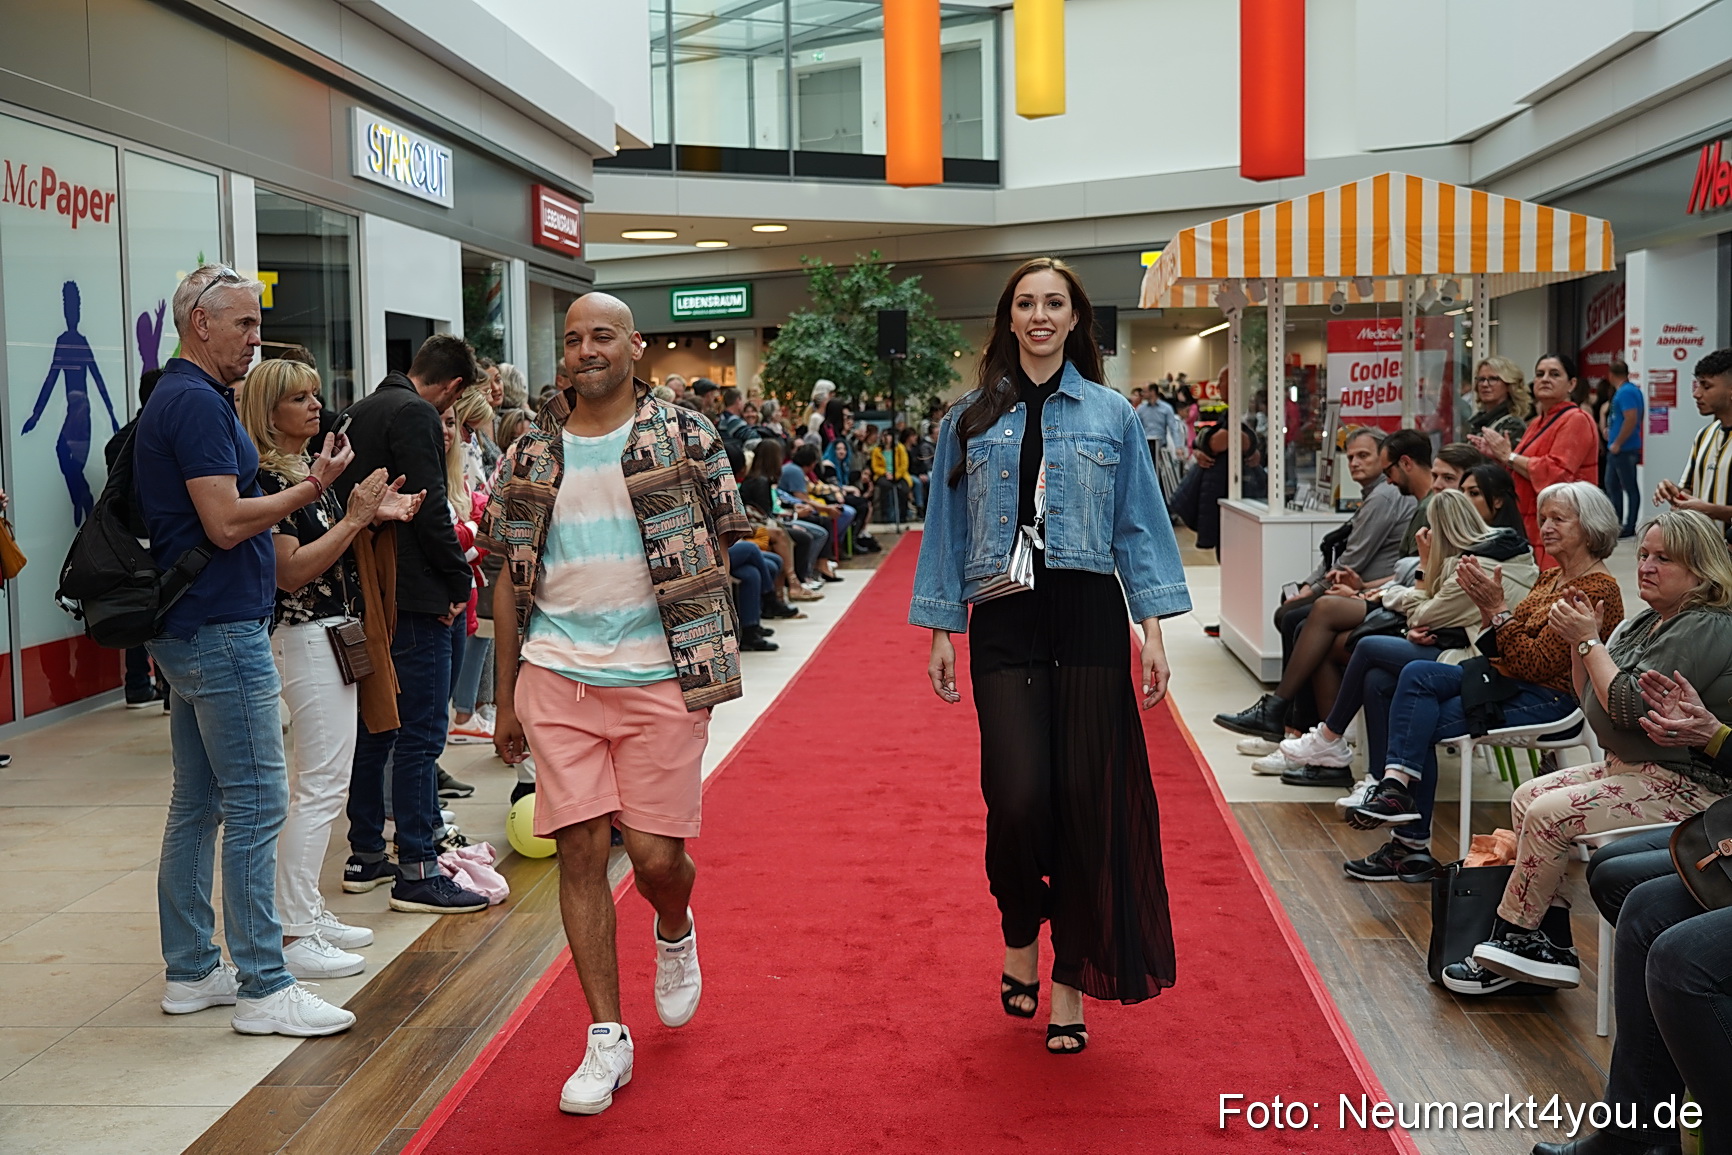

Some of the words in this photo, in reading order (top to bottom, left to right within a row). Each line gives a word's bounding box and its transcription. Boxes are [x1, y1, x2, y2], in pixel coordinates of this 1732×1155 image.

[368, 123, 448, 197] STARCUT
[1686, 141, 1732, 214] Me
[2, 159, 115, 229] McPaper
[544, 207, 578, 237] LEBENSRAUM
[677, 294, 742, 309] LEBENSRAUM
[1656, 336, 1705, 347] Abholung
[1350, 358, 1402, 382] Coole
